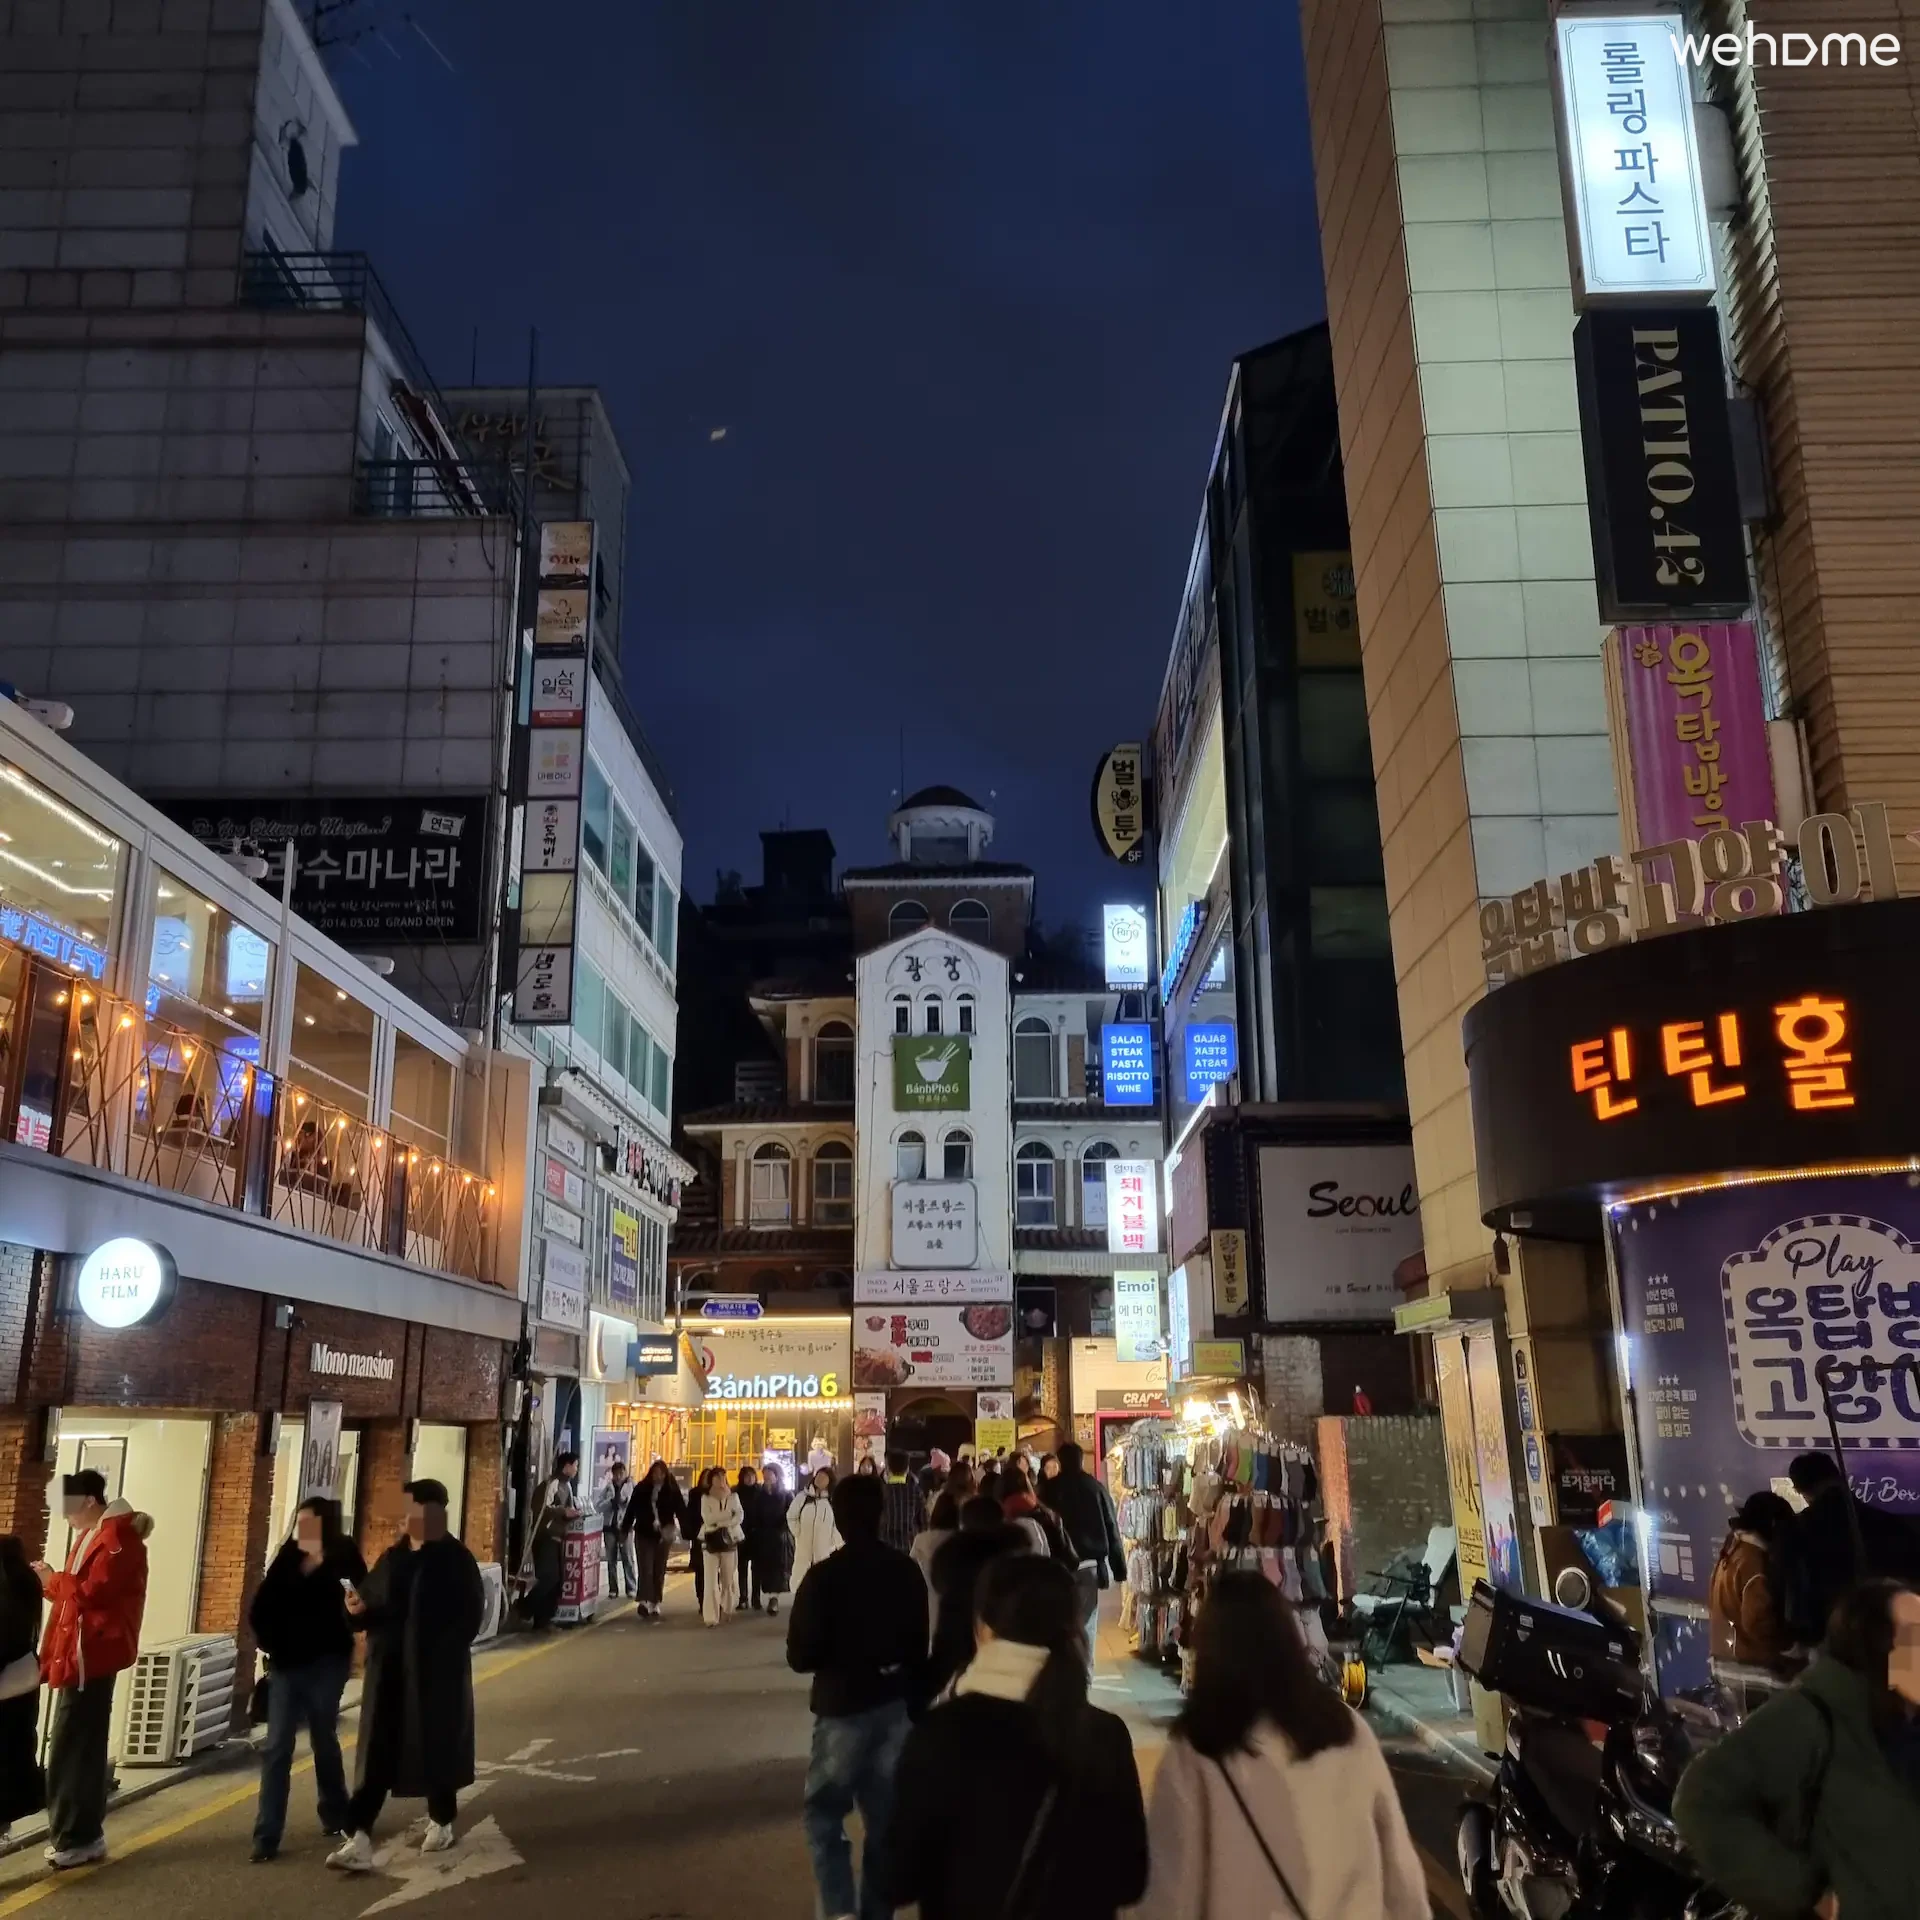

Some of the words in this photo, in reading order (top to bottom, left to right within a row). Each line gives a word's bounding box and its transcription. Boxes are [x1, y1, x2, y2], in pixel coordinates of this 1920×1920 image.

[1600, 41, 1671, 264] 롤링파스타
[1631, 325, 1706, 587] PATIO.42
[431, 816, 455, 831] 연극
[1630, 802, 1900, 942] 고양이
[385, 915, 422, 928] GRAND
[425, 915, 454, 928] OPEN
[1110, 1035, 1143, 1044] SALAD
[1111, 1047, 1143, 1056] STEAK
[1570, 997, 1855, 1121] 틴틴홀
[1111, 1059, 1144, 1068] PASTA
[1107, 1072, 1149, 1081] RISOTTO
[1116, 1085, 1142, 1093] WINE
[902, 1199, 966, 1214] 서울프랑스
[1307, 1181, 1418, 1218] Seoul
[1120, 1176, 1145, 1249] 돼지불백
[99, 1265, 143, 1281] HARU
[1783, 1234, 1883, 1298] Play
[101, 1285, 139, 1300] FILM
[892, 1276, 967, 1295] 서울프랑스
[1118, 1304, 1157, 1317] 에머이
[311, 1342, 348, 1376] Mono
[348, 1350, 394, 1381] mansion
[1562, 1475, 1617, 1493] 뜨거운바다
